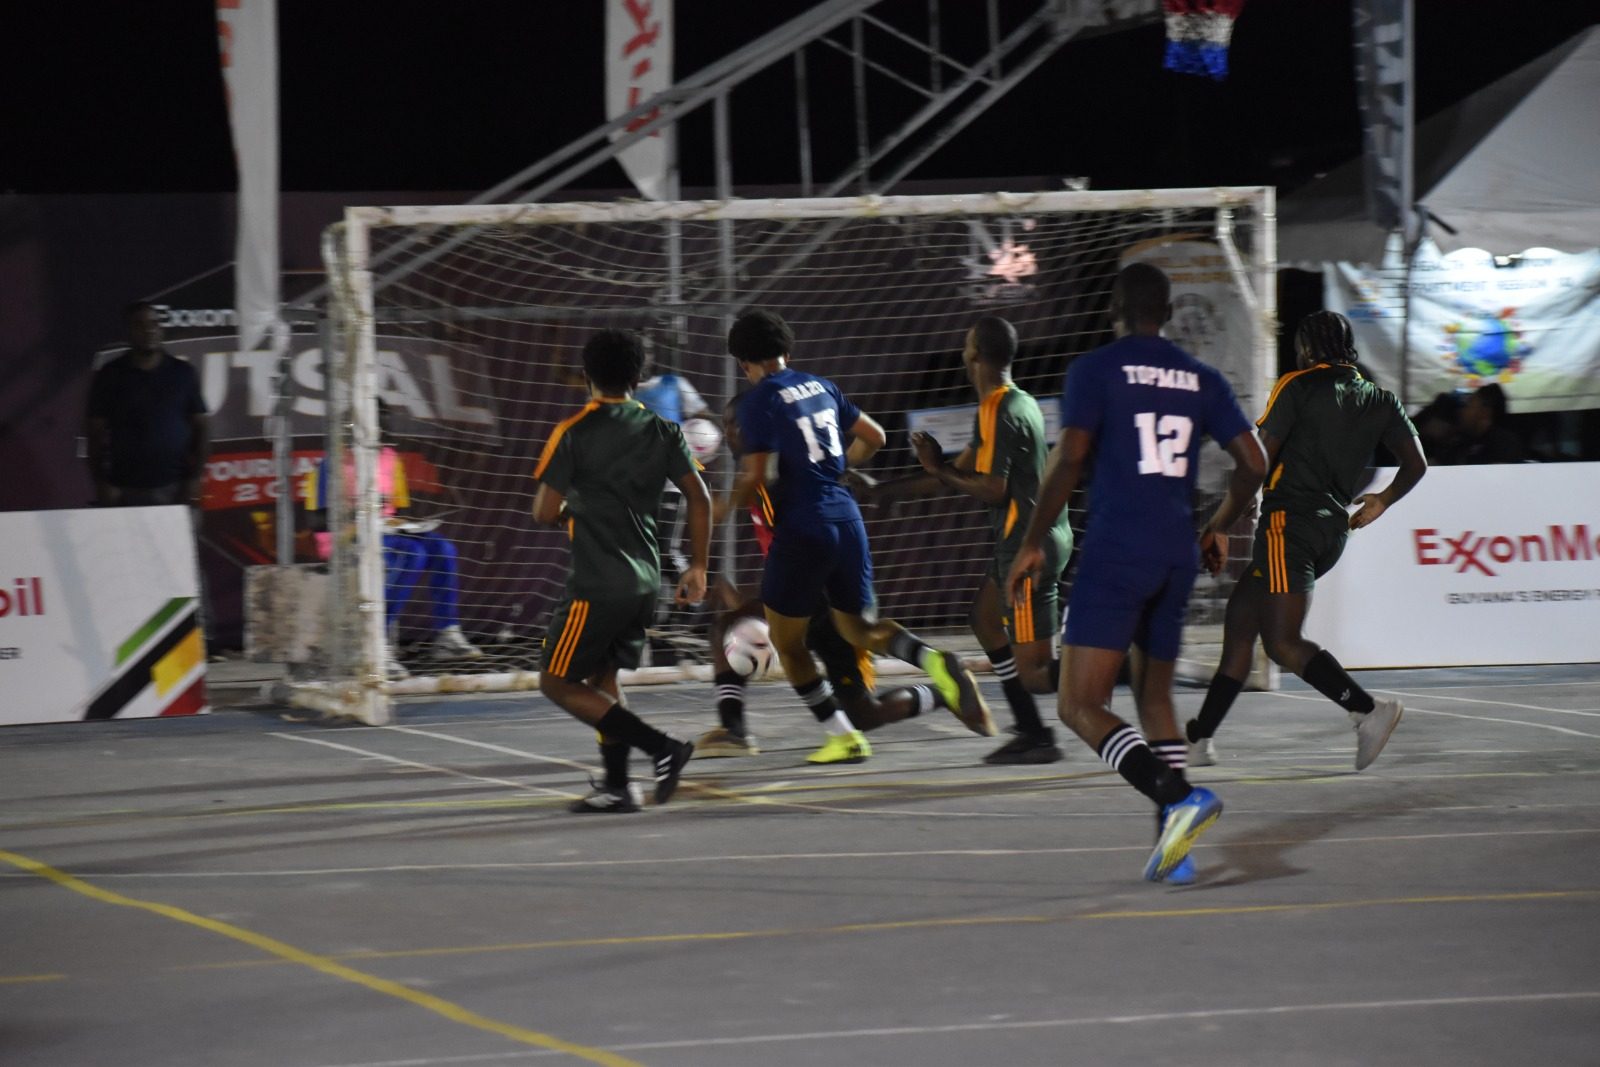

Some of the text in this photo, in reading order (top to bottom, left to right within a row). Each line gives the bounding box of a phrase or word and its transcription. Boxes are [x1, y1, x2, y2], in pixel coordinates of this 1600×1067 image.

[176, 346, 497, 424] UTSAL
[1121, 365, 1200, 392] TOPMAN
[796, 408, 844, 463] 17
[1134, 411, 1194, 478] 12
[1413, 524, 1600, 576] ExxonM
